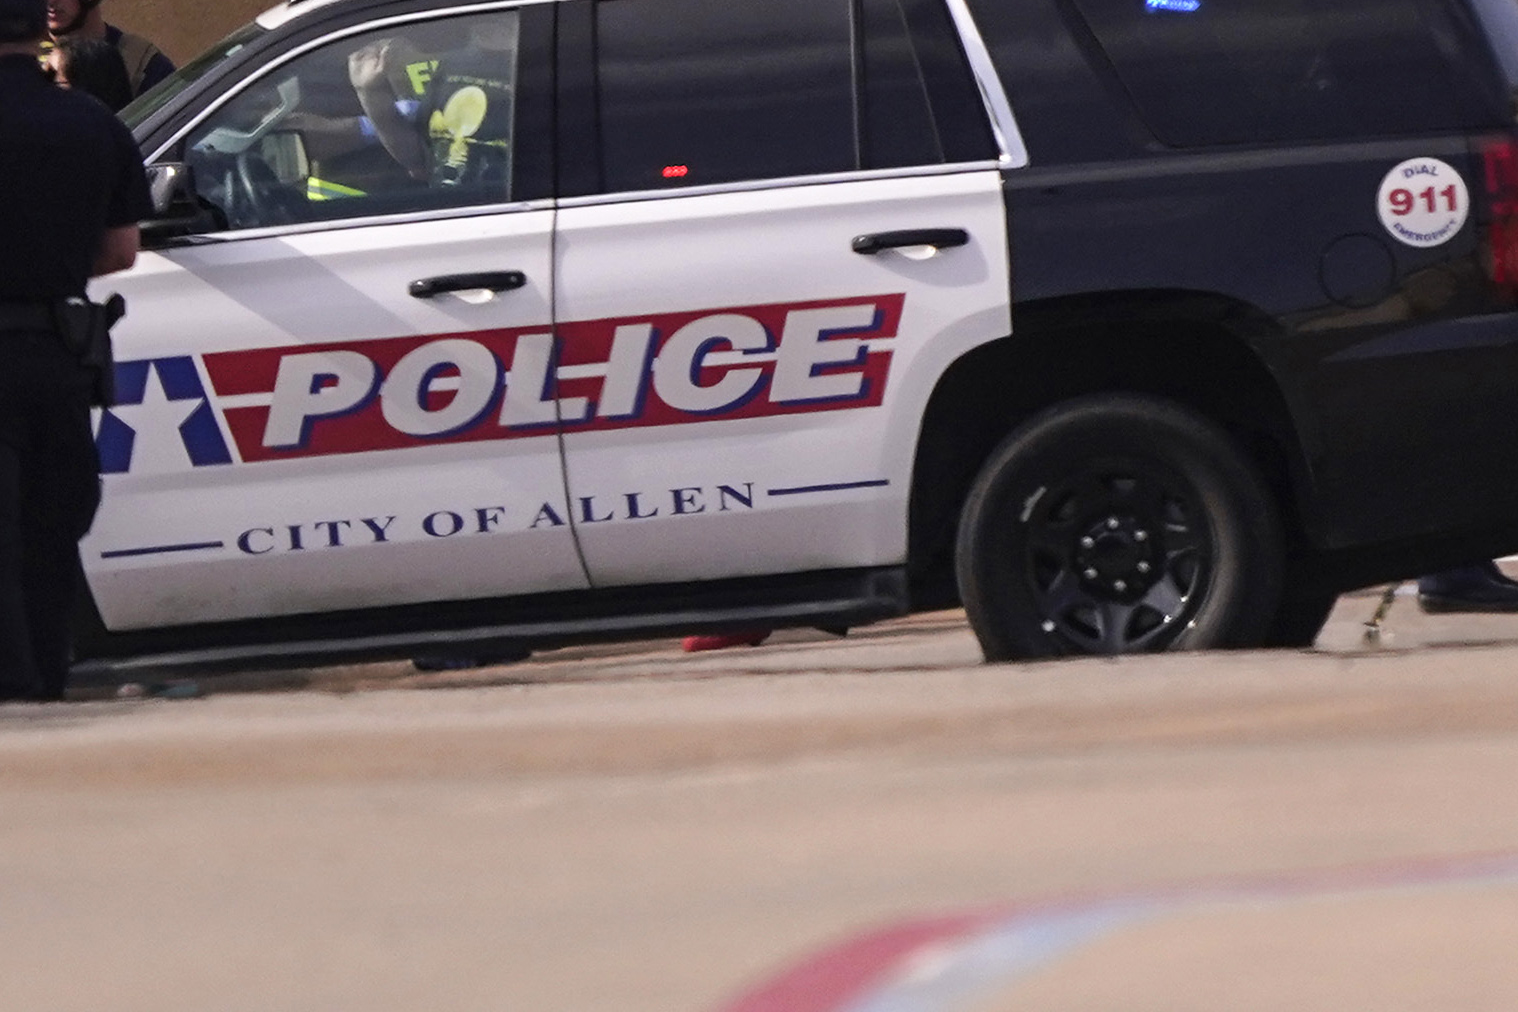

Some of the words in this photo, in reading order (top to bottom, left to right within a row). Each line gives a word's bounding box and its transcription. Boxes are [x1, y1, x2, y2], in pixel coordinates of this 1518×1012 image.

[1403, 165, 1438, 178] DIAL
[1388, 184, 1457, 216] 911
[261, 303, 886, 450] POLICE
[236, 515, 397, 555] CITY
[422, 506, 506, 538] OF
[530, 482, 755, 529] ALLEN
